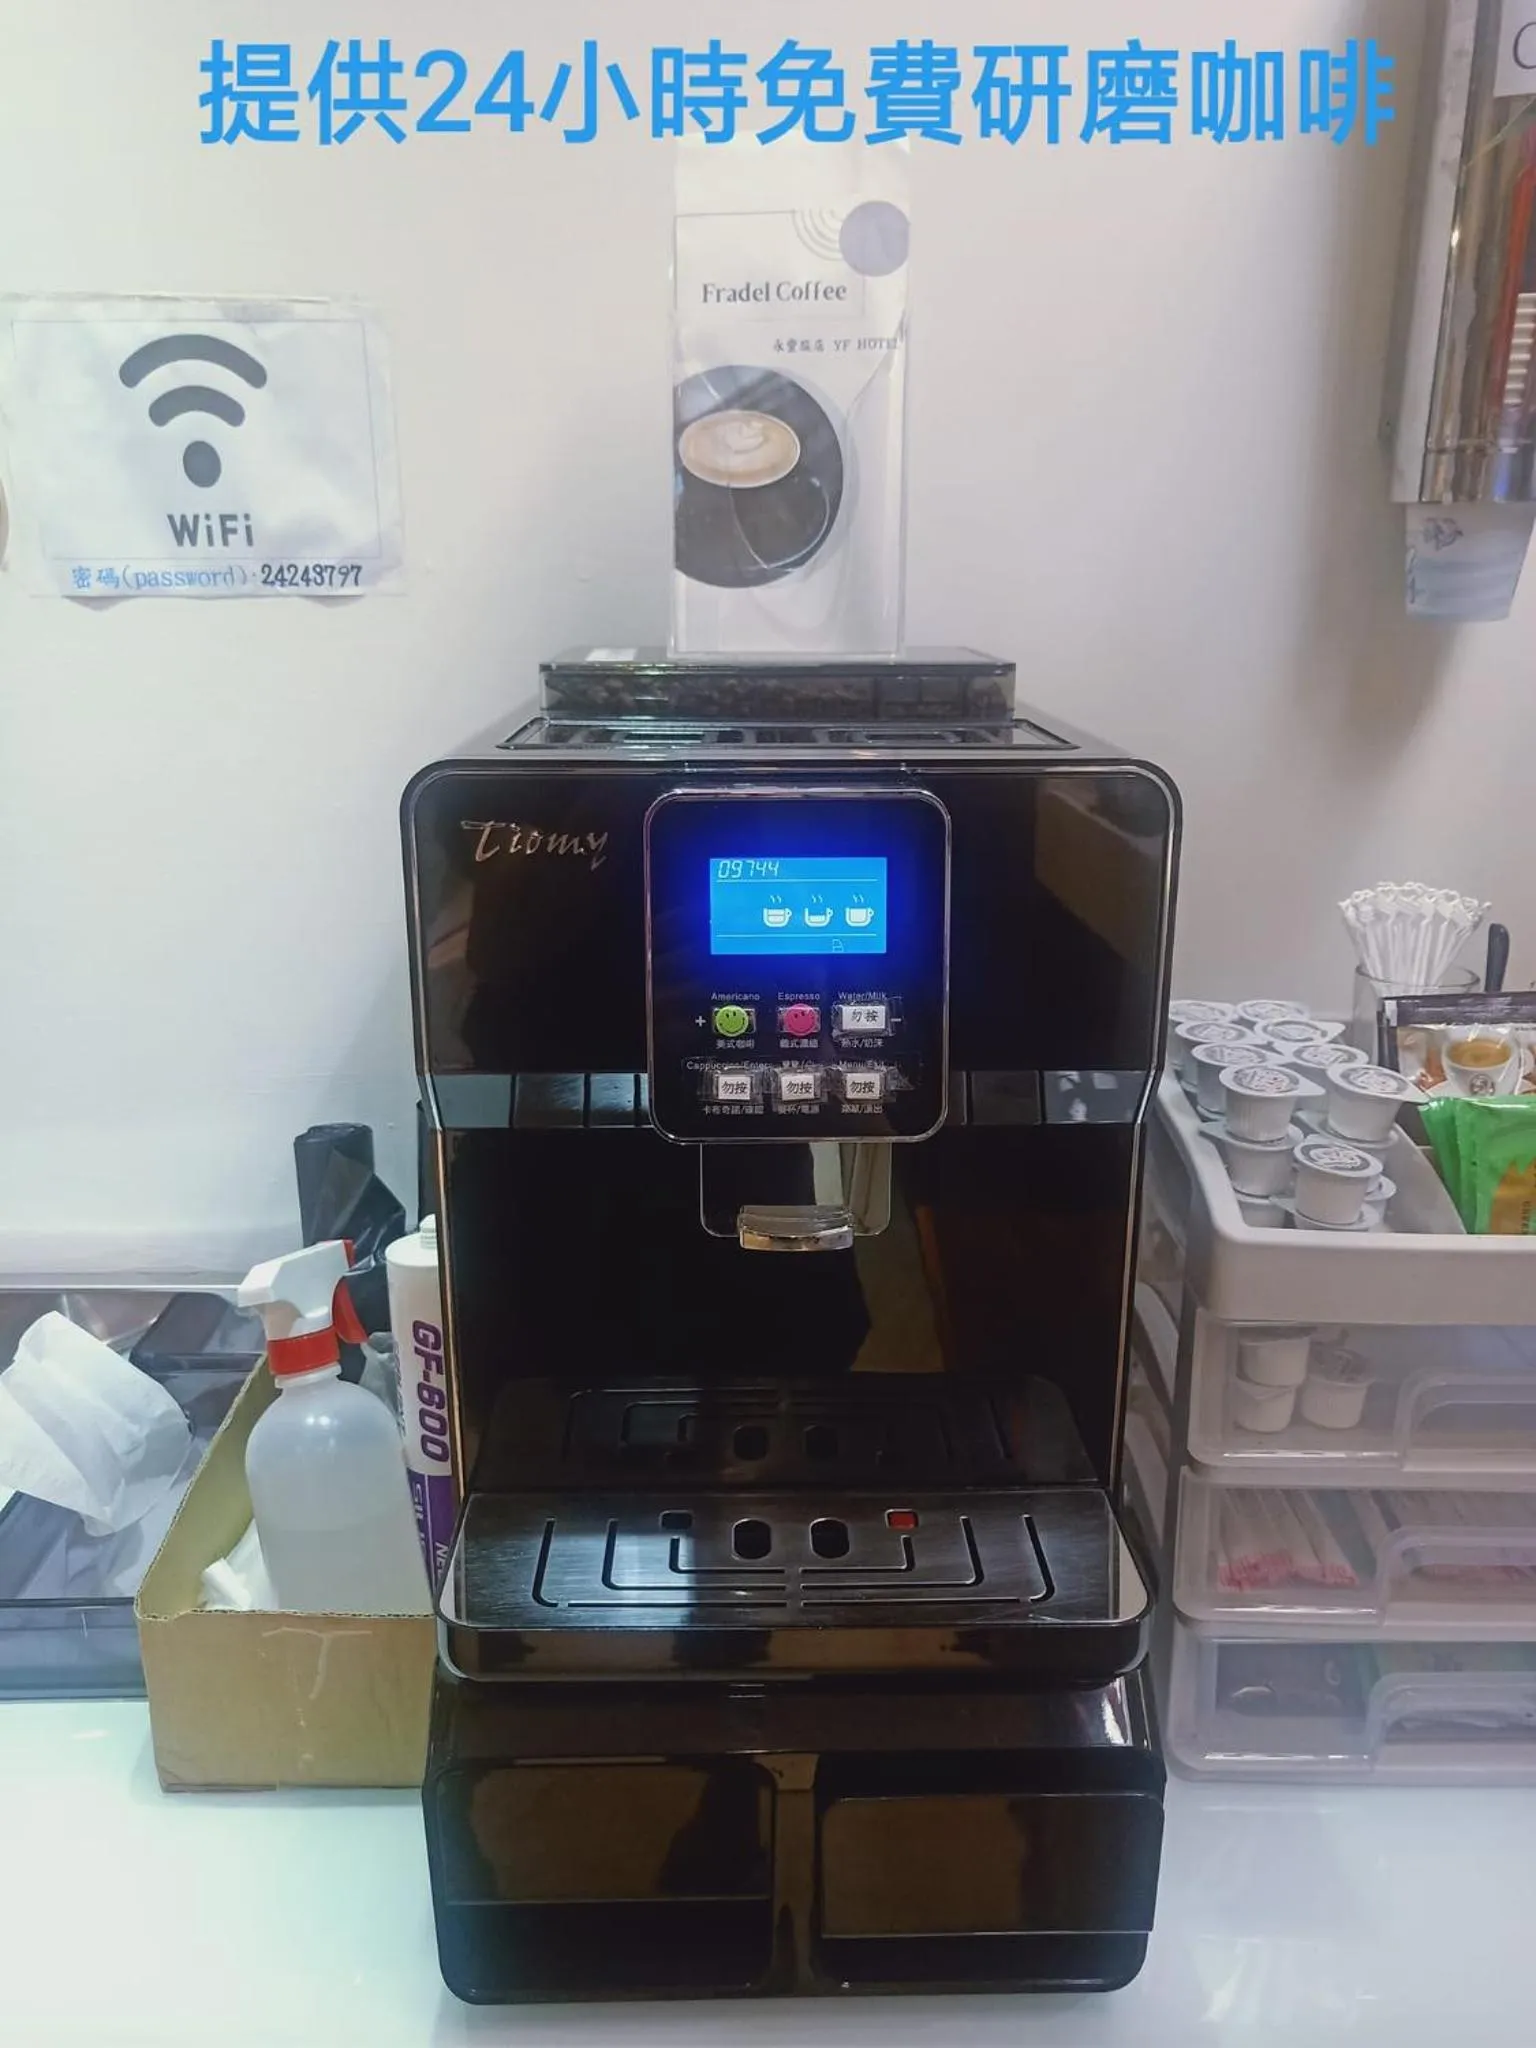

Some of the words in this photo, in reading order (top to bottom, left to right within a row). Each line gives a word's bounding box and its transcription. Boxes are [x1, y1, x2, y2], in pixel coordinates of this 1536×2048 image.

[701, 282, 770, 303] Fradel
[776, 280, 847, 301] Coffee
[167, 513, 255, 548] WiFi
[460, 820, 608, 872] Tiomy
[718, 860, 779, 879] 09744
[711, 992, 760, 1001] Americano
[778, 992, 820, 1002] Espresso
[721, 1080, 749, 1095] 勿按
[785, 1080, 814, 1095] 勿按
[850, 1080, 876, 1095] 勿按
[411, 1318, 451, 1463] GF-600
